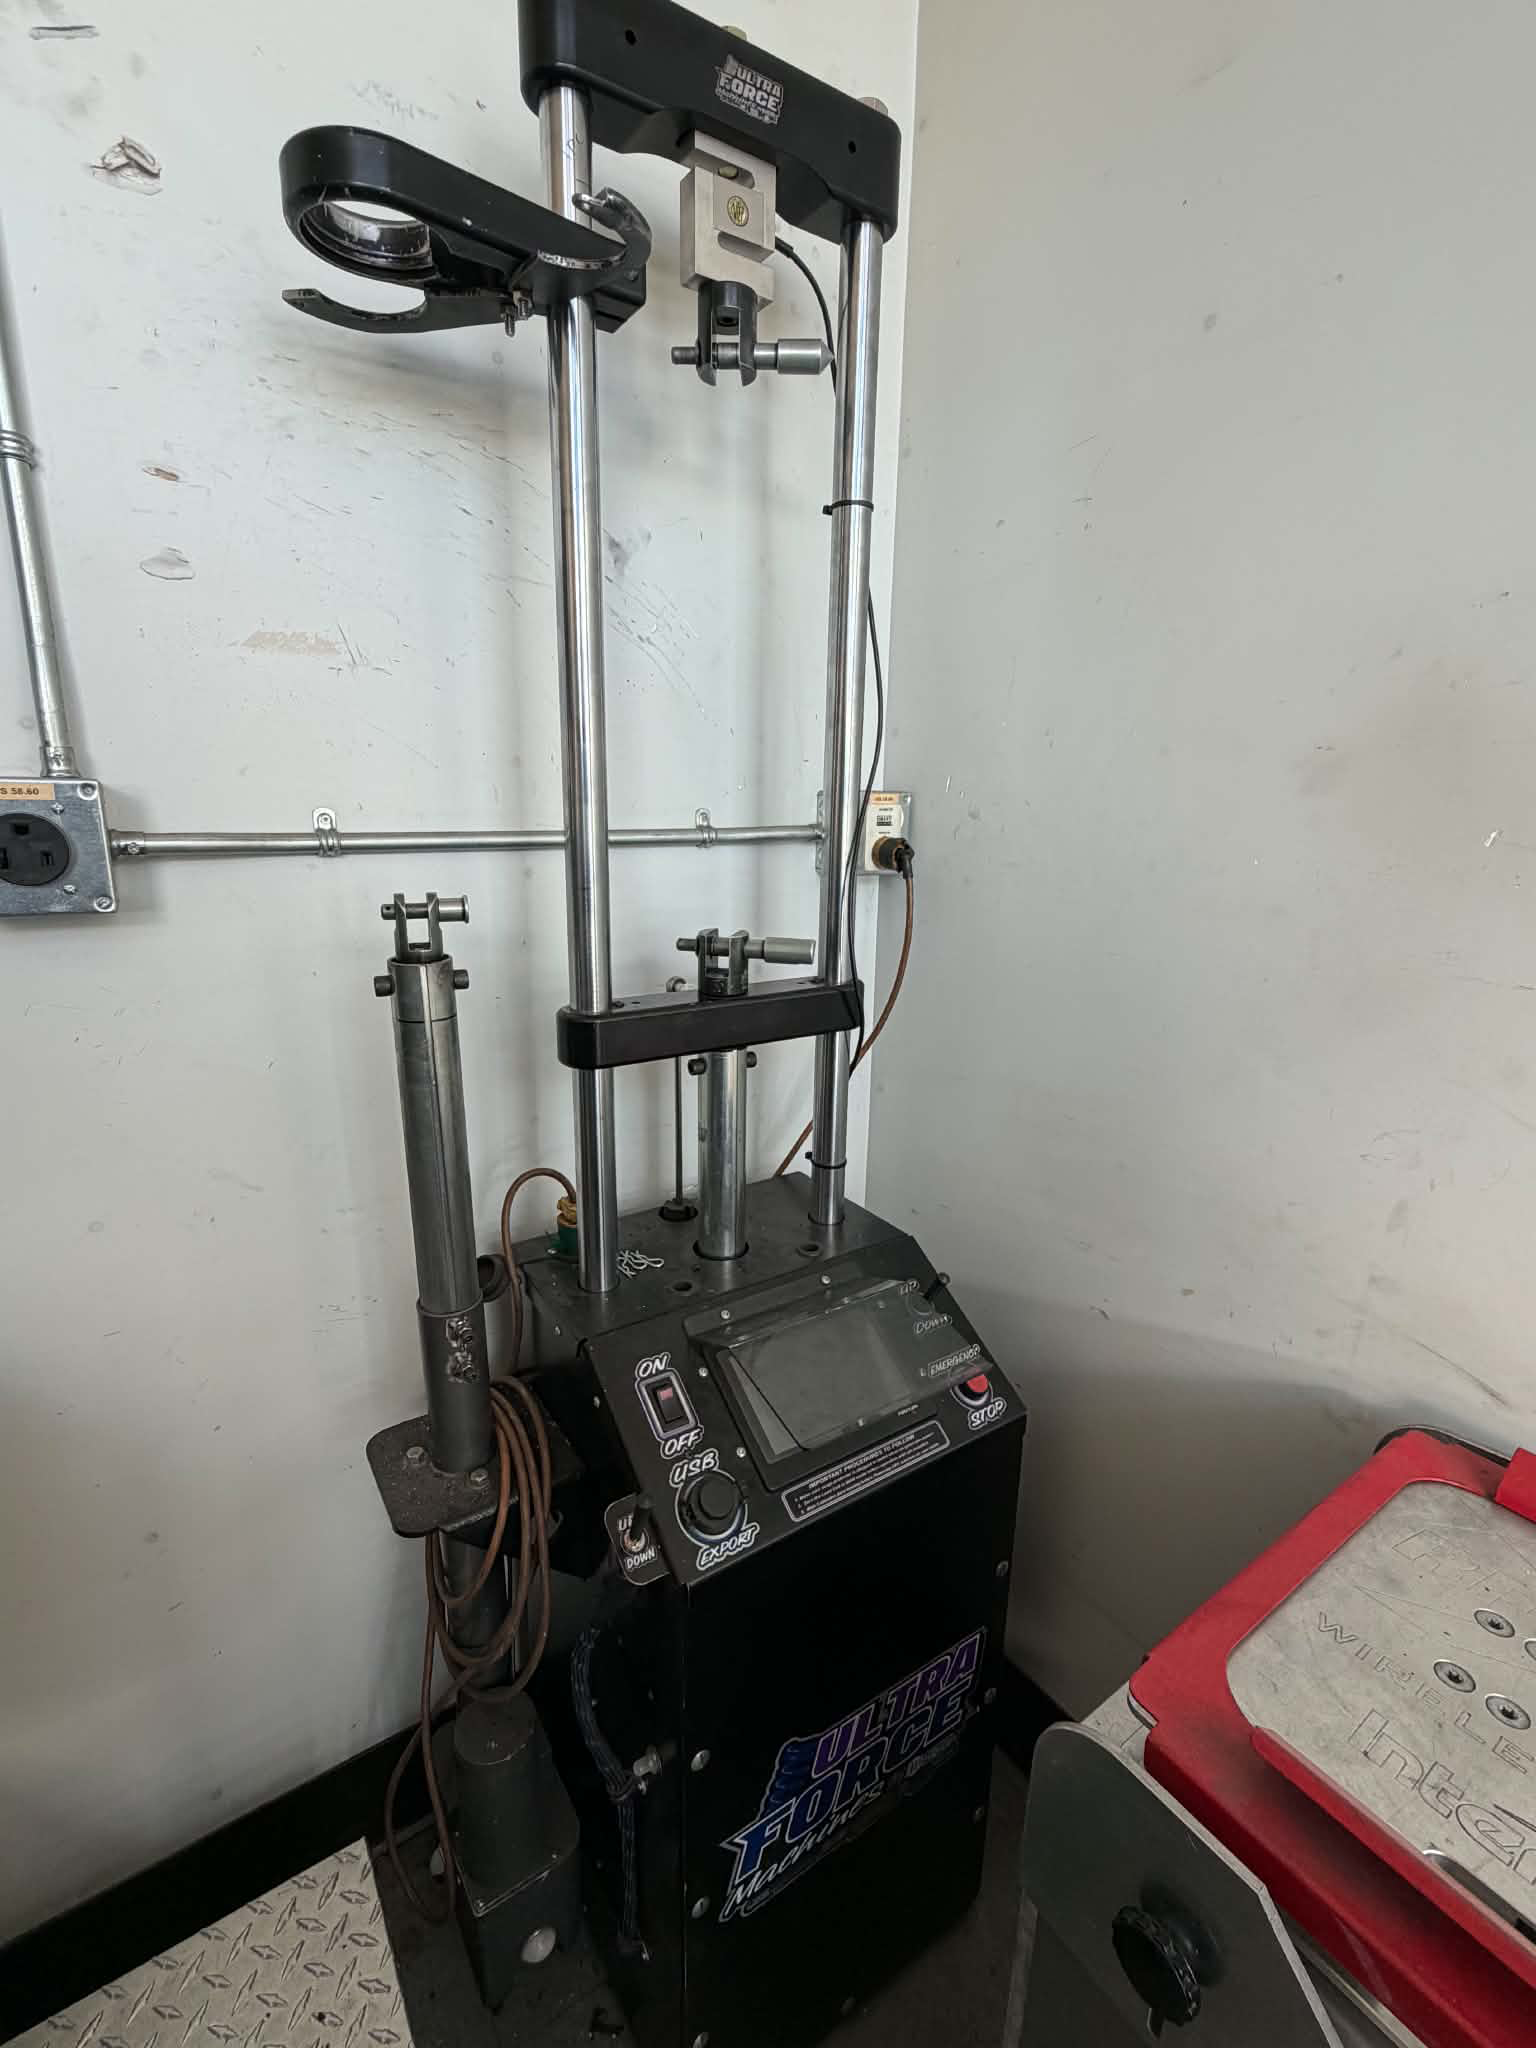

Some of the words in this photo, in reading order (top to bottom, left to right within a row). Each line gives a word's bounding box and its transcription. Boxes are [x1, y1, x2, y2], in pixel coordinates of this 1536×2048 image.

[719, 72, 780, 113] FORCE
[737, 67, 781, 98] ULTRA
[638, 1354, 668, 1378] ON
[970, 1400, 1004, 1427] STOP
[664, 1428, 700, 1455] OFF
[673, 1451, 715, 1483] USB
[626, 1547, 655, 1569] DOWN
[700, 1527, 757, 1566] EXPORT
[811, 1632, 981, 1779] ULTRA
[729, 1674, 974, 1884] FORCE
[724, 1782, 884, 1919] Machines
